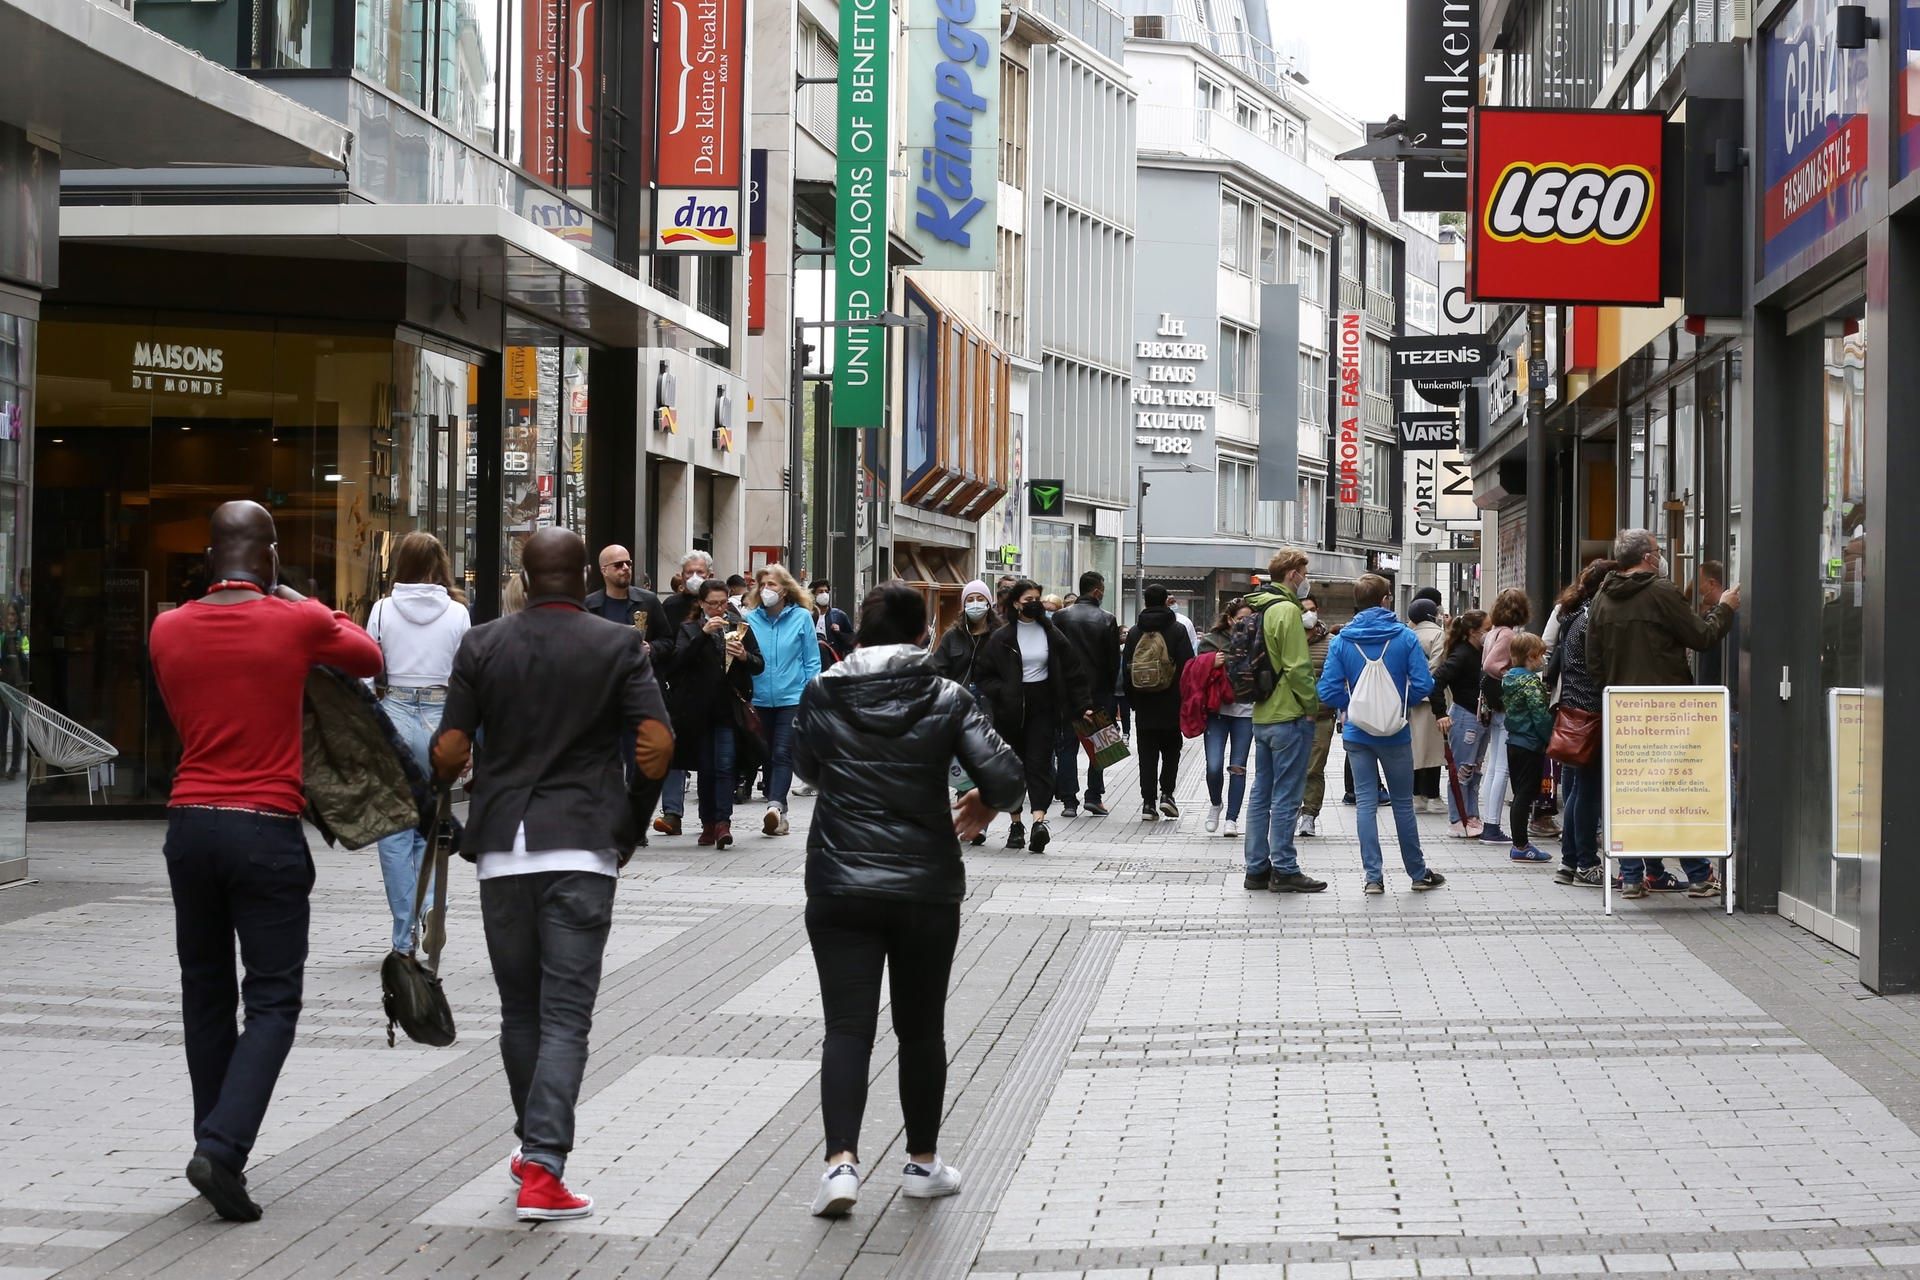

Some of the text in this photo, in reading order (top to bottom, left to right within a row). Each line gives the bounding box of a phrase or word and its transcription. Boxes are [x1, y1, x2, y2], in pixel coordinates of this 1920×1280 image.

[719, 54, 728, 83] KÖLN
[695, 71, 714, 129] kleine
[851, 117, 873, 152] OF
[695, 136, 713, 174] Das
[674, 196, 728, 227] dm
[1489, 167, 1650, 240] LEGO
[849, 166, 873, 277] COLORS
[848, 290, 871, 386] UNITED
[133, 341, 224, 373] MAISONS
[1136, 342, 1208, 360] BECKER
[1148, 365, 1196, 383] HAUS
[133, 375, 223, 396] DE MONDE
[1131, 384, 1165, 405] FÜR
[1417, 380, 1471, 390] hunkemöller
[1340, 313, 1360, 504] EUROPA FASHION
[1136, 412, 1207, 430] KULTUR
[1401, 421, 1454, 442] VANS
[1152, 436, 1192, 454] 1882
[1615, 699, 1717, 708] Vereinbare deinen
[1615, 712, 1718, 724] ganz persönlichen
[1615, 726, 1690, 736] Abholtermin!
[1616, 767, 1645, 777] 0221/
[1615, 806, 1710, 816] Sicher und exklusiv.
